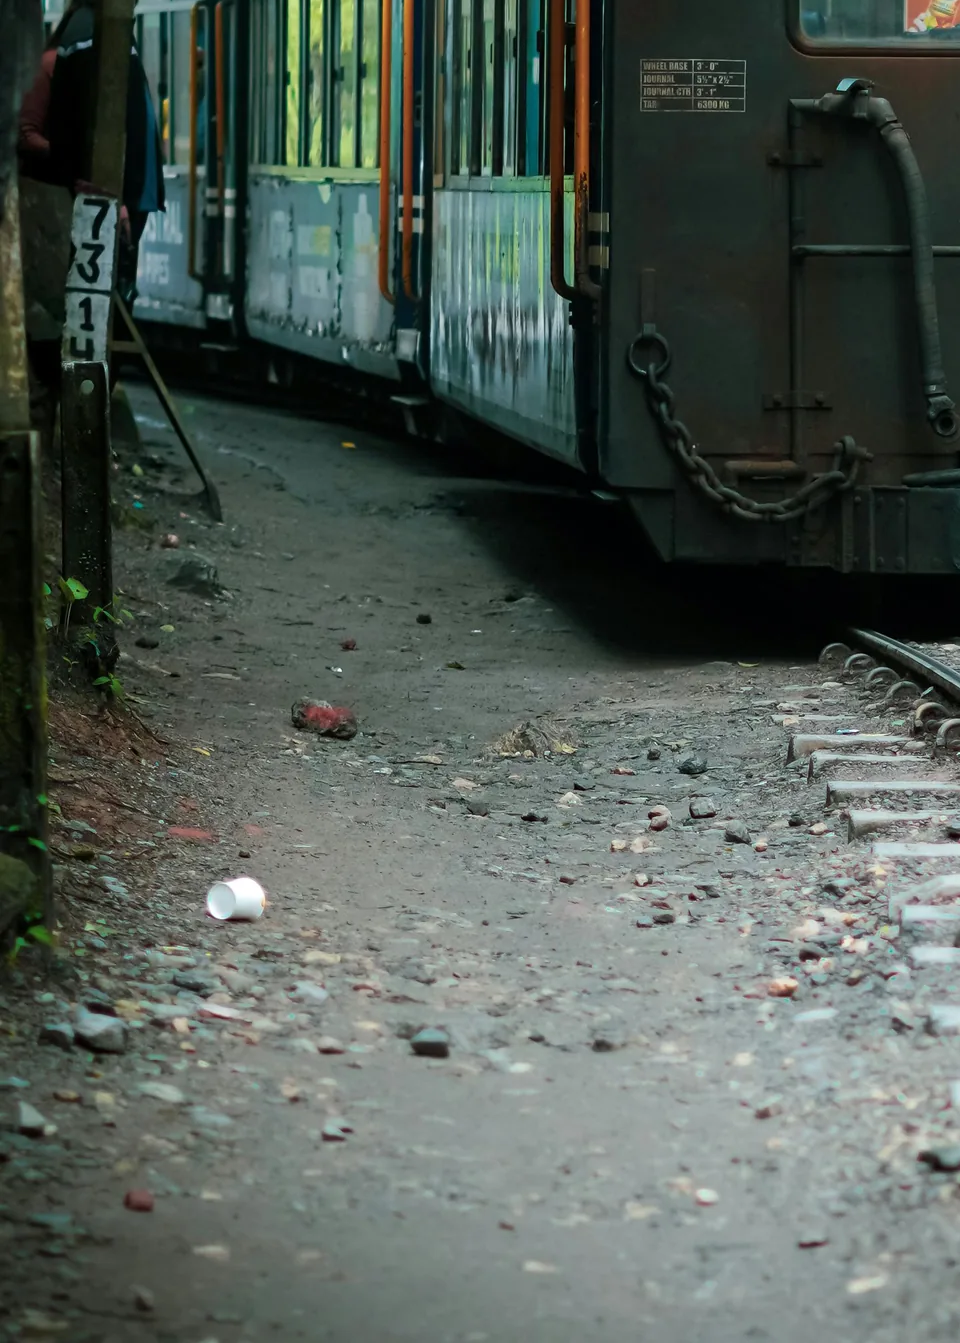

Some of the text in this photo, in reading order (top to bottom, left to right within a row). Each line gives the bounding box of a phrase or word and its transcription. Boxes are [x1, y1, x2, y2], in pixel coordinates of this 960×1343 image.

[643, 62, 688, 70] WHEEL BASE
[643, 74, 676, 83] JOURNAL
[719, 101, 730, 109] KG
